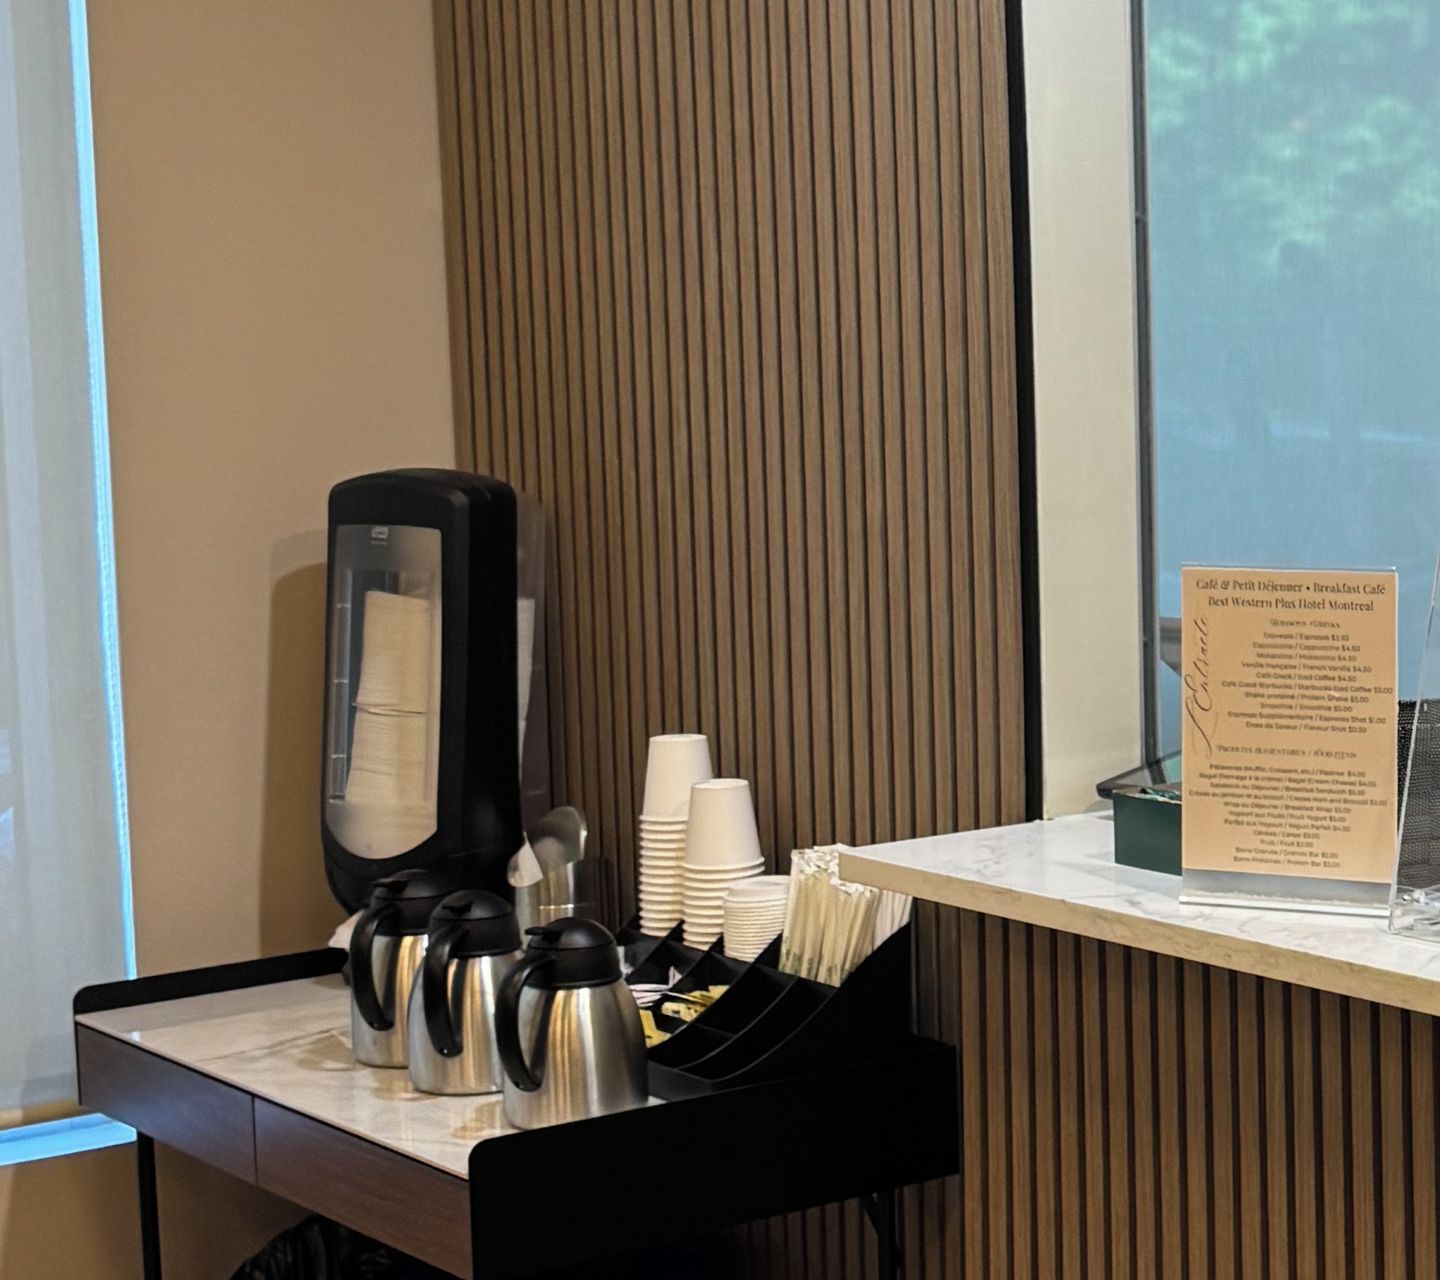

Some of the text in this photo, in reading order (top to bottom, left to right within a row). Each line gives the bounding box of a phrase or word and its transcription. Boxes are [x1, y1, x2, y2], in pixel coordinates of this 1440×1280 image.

[1196, 579, 1386, 595] Café & Petit Déjeuner Breakfast Café
[1208, 596, 1374, 612] Best Western Plus Hotel Montreal
